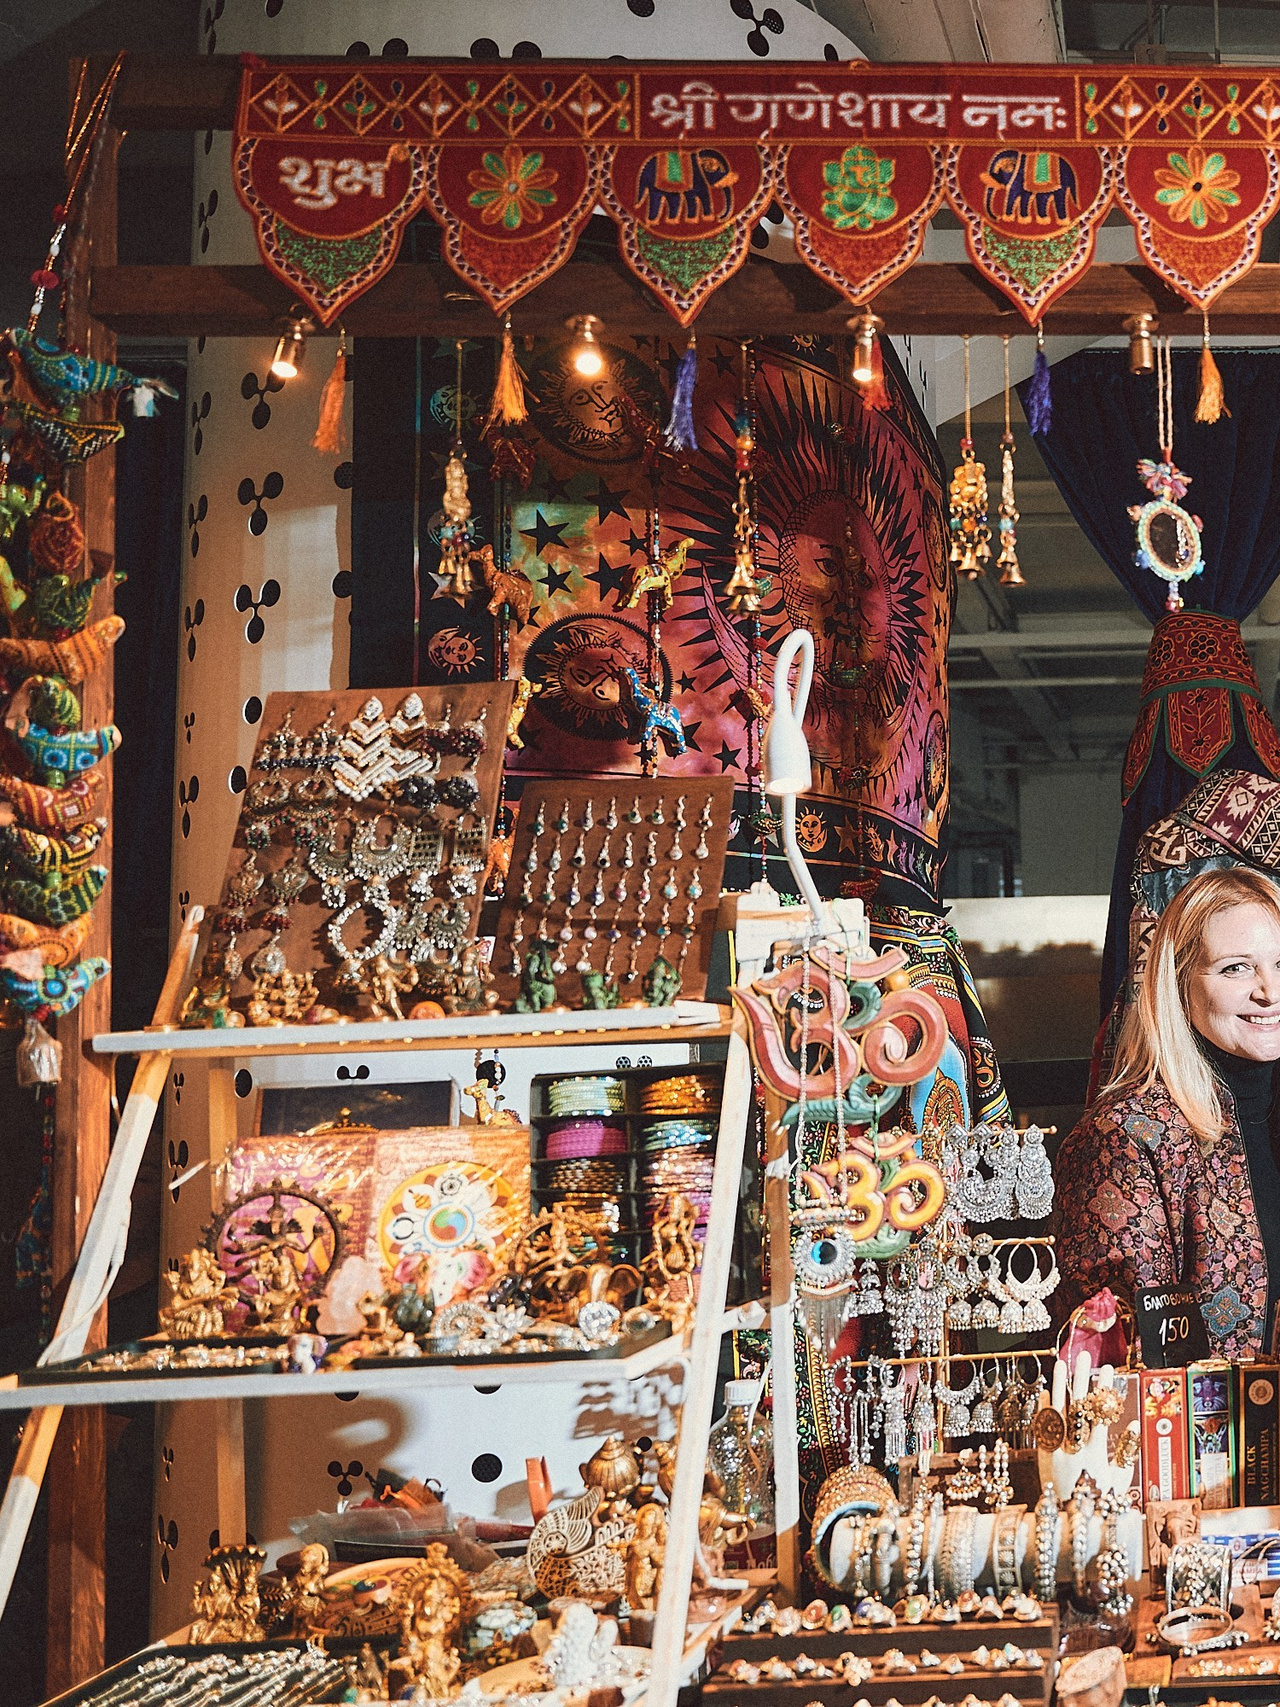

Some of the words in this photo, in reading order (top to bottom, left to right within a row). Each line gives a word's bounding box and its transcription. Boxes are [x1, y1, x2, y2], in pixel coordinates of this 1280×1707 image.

[650, 82, 719, 130] श्री
[724, 83, 952, 130] गणेशाय
[962, 95, 1067, 130] नमः
[278, 157, 386, 210] शुभ
[1158, 1316, 1190, 1346] 150
[1160, 1438, 1171, 1486] GOODLUCK
[1246, 1445, 1257, 1485] BLACK
[1260, 1428, 1270, 1501] NAGCHAMPA
